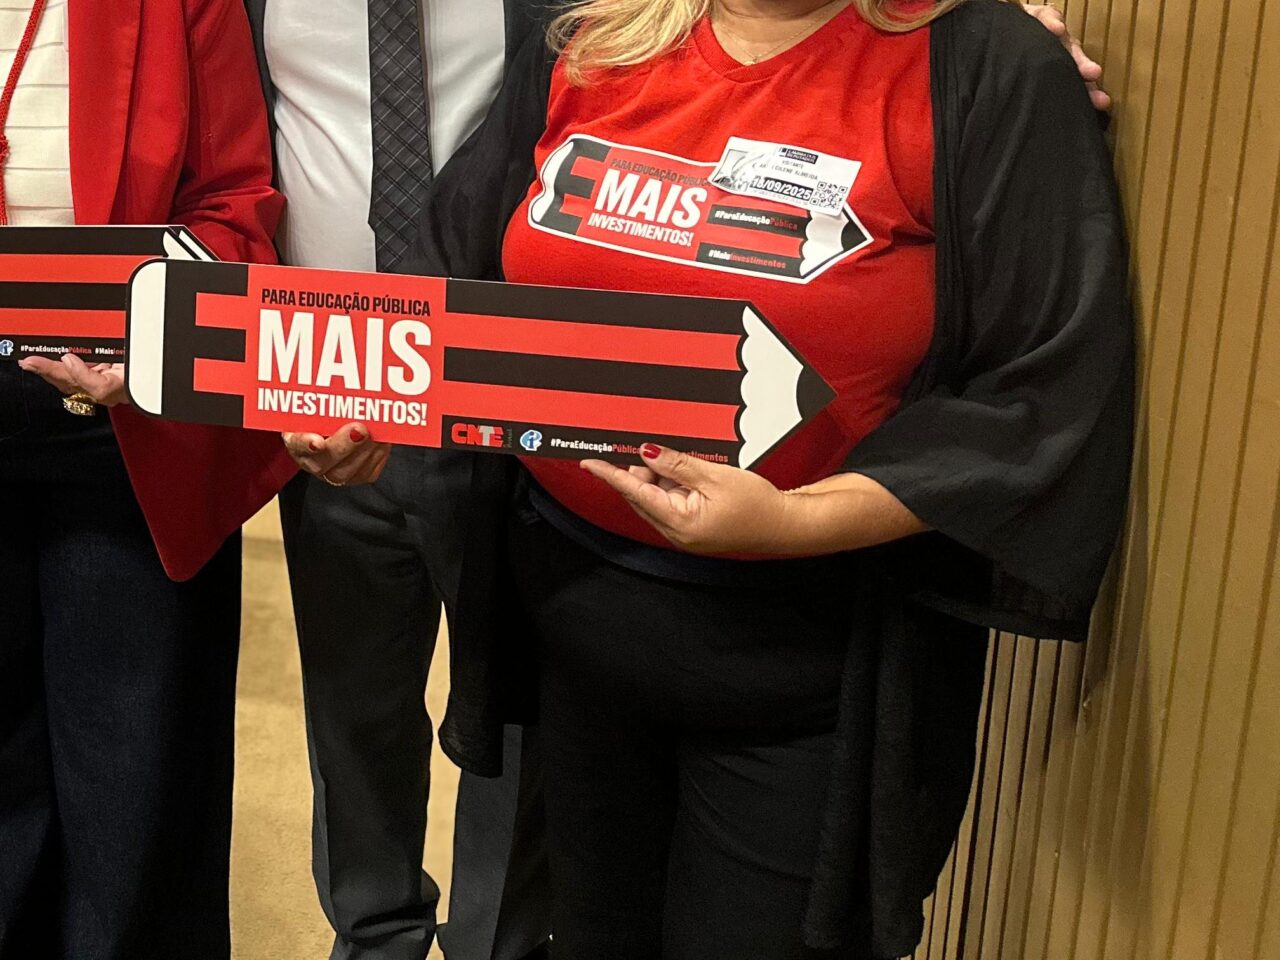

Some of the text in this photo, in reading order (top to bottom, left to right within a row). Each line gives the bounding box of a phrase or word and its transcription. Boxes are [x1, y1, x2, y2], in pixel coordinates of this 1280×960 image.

[611, 158, 632, 170] PARA
[632, 163, 677, 180] EDUCAÇÃO
[594, 168, 708, 228] MAIS
[752, 178, 812, 200] 18/09/2025
[588, 213, 694, 247] INVESTIMENTOS!
[262, 289, 430, 316] PARA EDUCAÇÃO PÚBLICA
[258, 308, 432, 396] MAIS
[258, 388, 428, 426] INVESTIMENTOS!
[452, 423, 504, 448] CNTE
